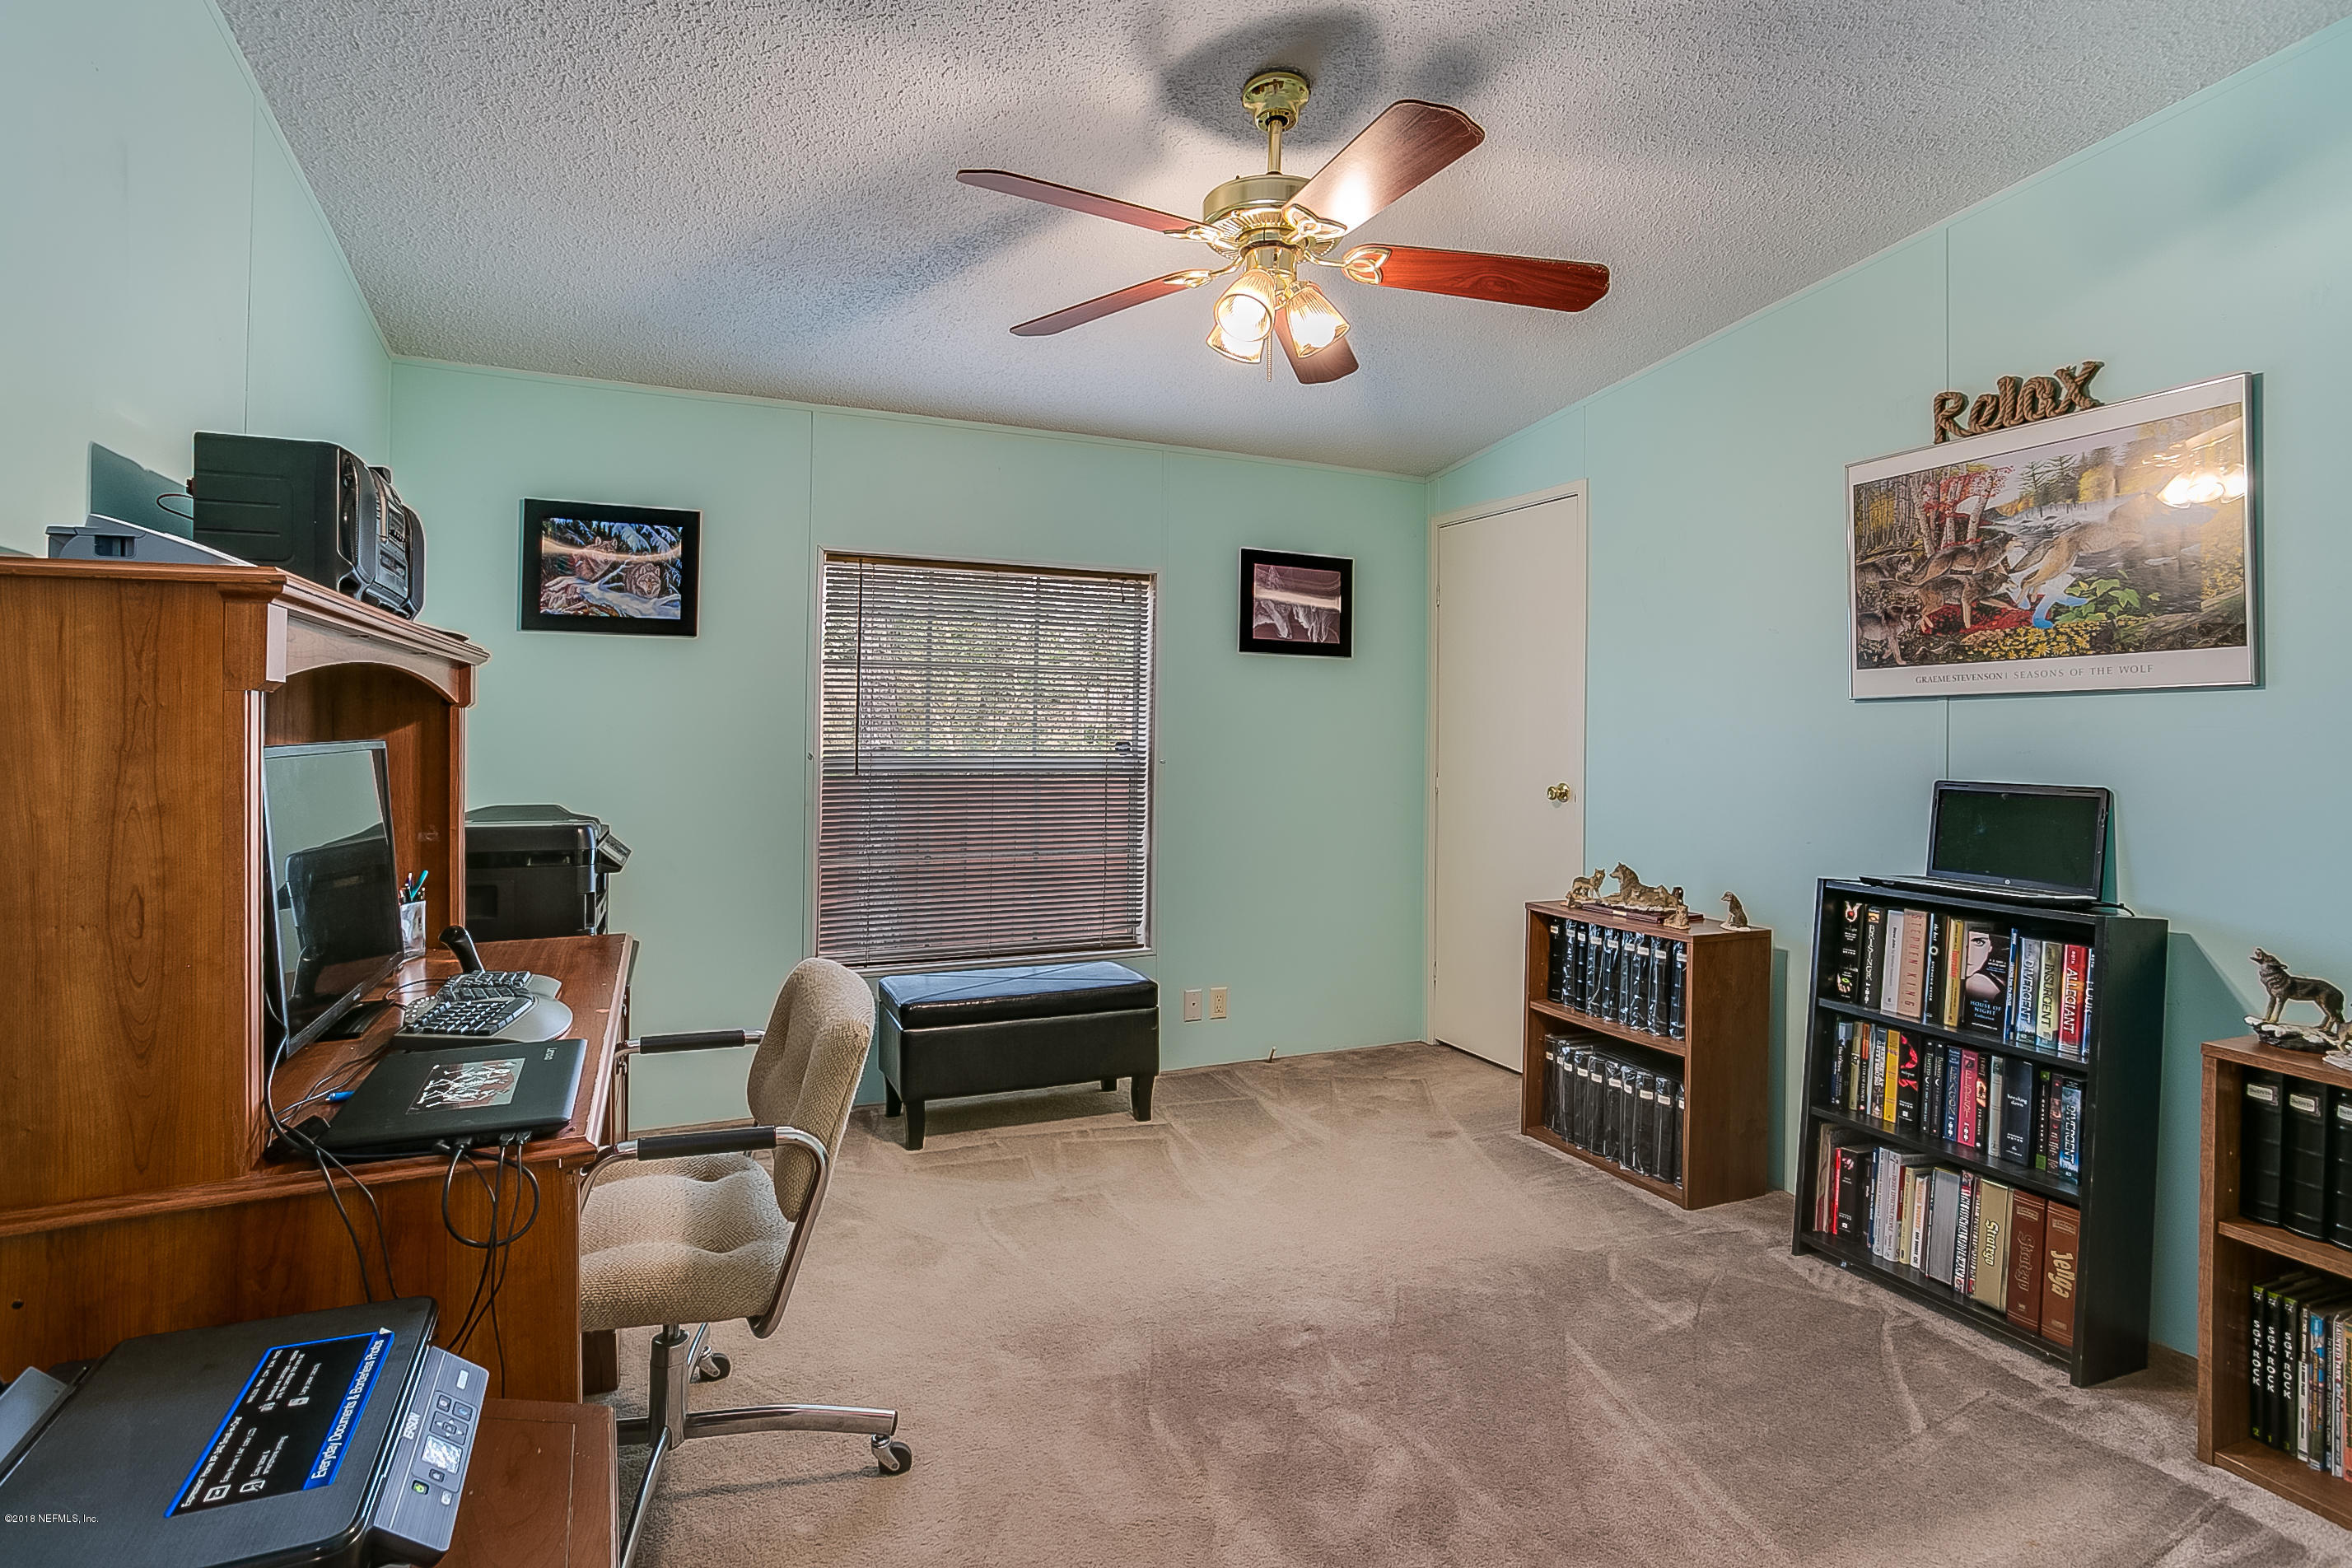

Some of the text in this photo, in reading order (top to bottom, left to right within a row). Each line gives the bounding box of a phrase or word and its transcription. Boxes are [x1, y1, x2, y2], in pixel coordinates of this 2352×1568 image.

[1916, 664, 2154, 684] GRAEME STEVENSON SEASONS OF THE WOLF
[1905, 914, 1921, 1007] STEPHEN KING
[1970, 1001, 1990, 1009] HOUSE
[2020, 960, 2034, 1023] DIVERGENT
[2041, 964, 2054, 1028] INSURGENT
[2063, 968, 2078, 1034] ALLEGIANT
[1974, 1007, 1996, 1015] NIGHT
[2007, 1094, 2028, 1105] breaking
[1982, 1220, 2000, 1267] Stratego
[2014, 1232, 2035, 1292] Stratego
[2047, 1250, 2075, 1299] Jenga
[2253, 1320, 2262, 1348] SGT.
[2267, 1327, 2278, 1357] SGT.
[2284, 1332, 2294, 1364] SGT.
[2252, 1351, 2261, 1386] ROCK
[2266, 1356, 2275, 1393] ROCK
[2283, 1363, 2291, 1399] ROCK
[310, 1442, 343, 1478] Everyday
[328, 1401, 357, 1441] Documents
[348, 1360, 375, 1393] Borderless
[364, 1340, 385, 1360] Photos
[403, 1411, 421, 1440] EPSON
